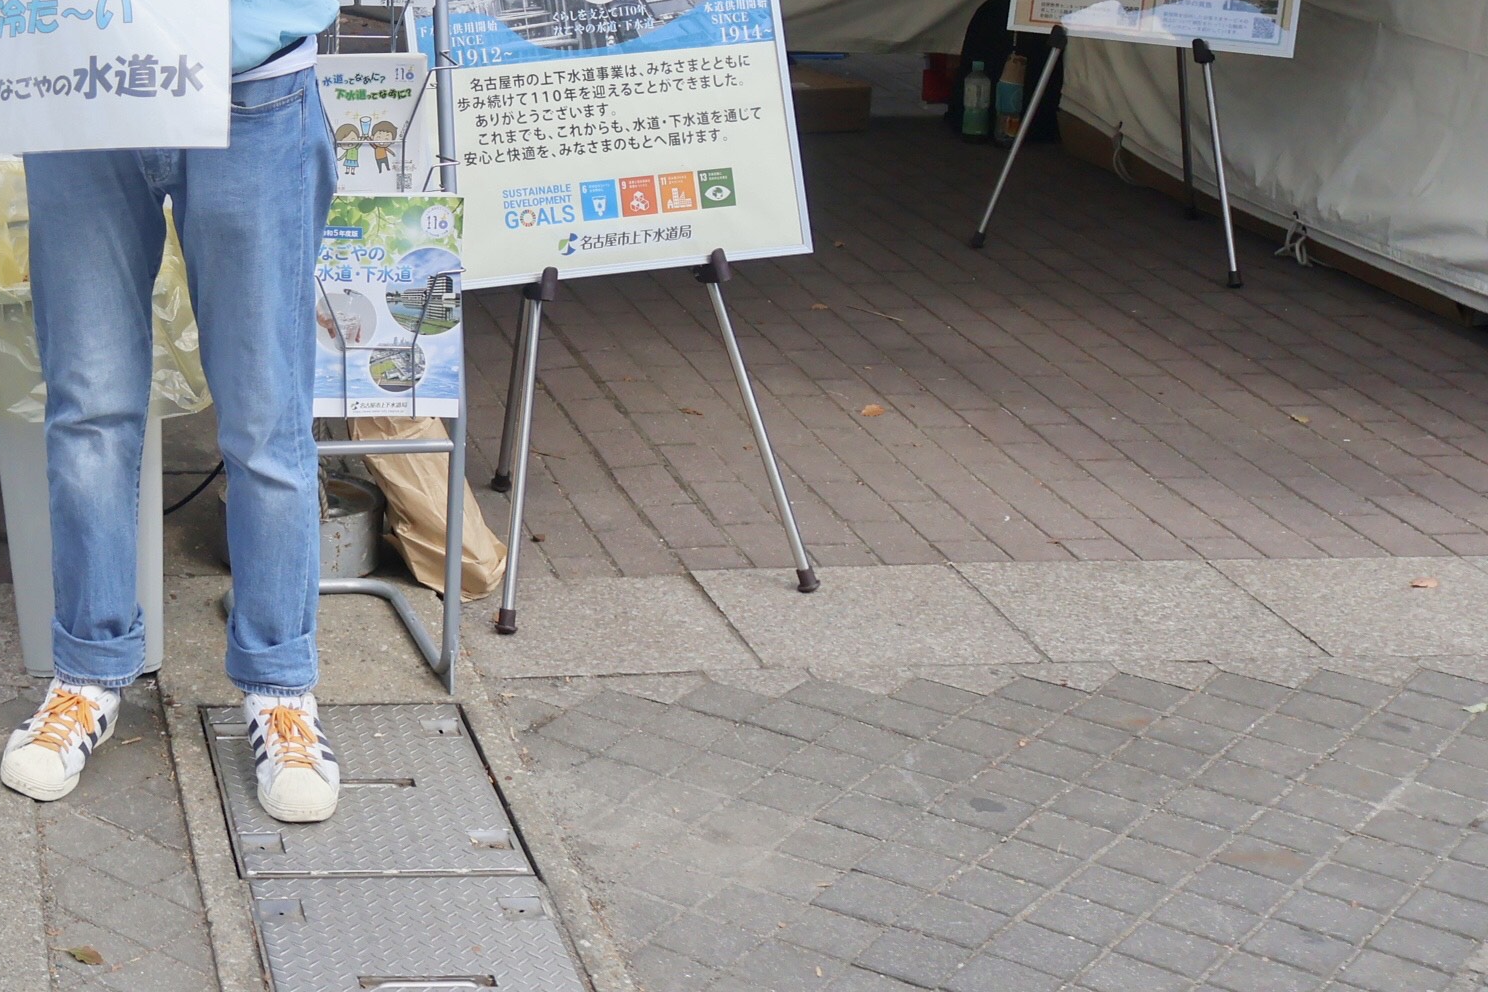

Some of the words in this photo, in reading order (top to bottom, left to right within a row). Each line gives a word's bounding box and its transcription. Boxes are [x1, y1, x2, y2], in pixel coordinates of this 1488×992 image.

[711, 11, 749, 24] SINCE
[451, 35, 484, 48] INCE
[470, 55, 751, 92] 名古屋市の上下水道事業は、みなさまとともに
[457, 73, 745, 112] 歩み続けて110年を迎えることができました。
[475, 103, 617, 128] ありがとうございます。
[478, 106, 762, 146] これまでも、これからも、水道・下水道を通じて
[464, 128, 729, 166] 安心と快適を、みなさまのもとへ届けます。
[502, 183, 572, 199] SUSTAINABLE
[621, 180, 627, 190] 9
[503, 194, 572, 209] DEVELOPMENT
[504, 205, 575, 230] GOALS
[580, 224, 692, 251] 名古屋市上下水道局
[318, 245, 385, 261] なごやの
